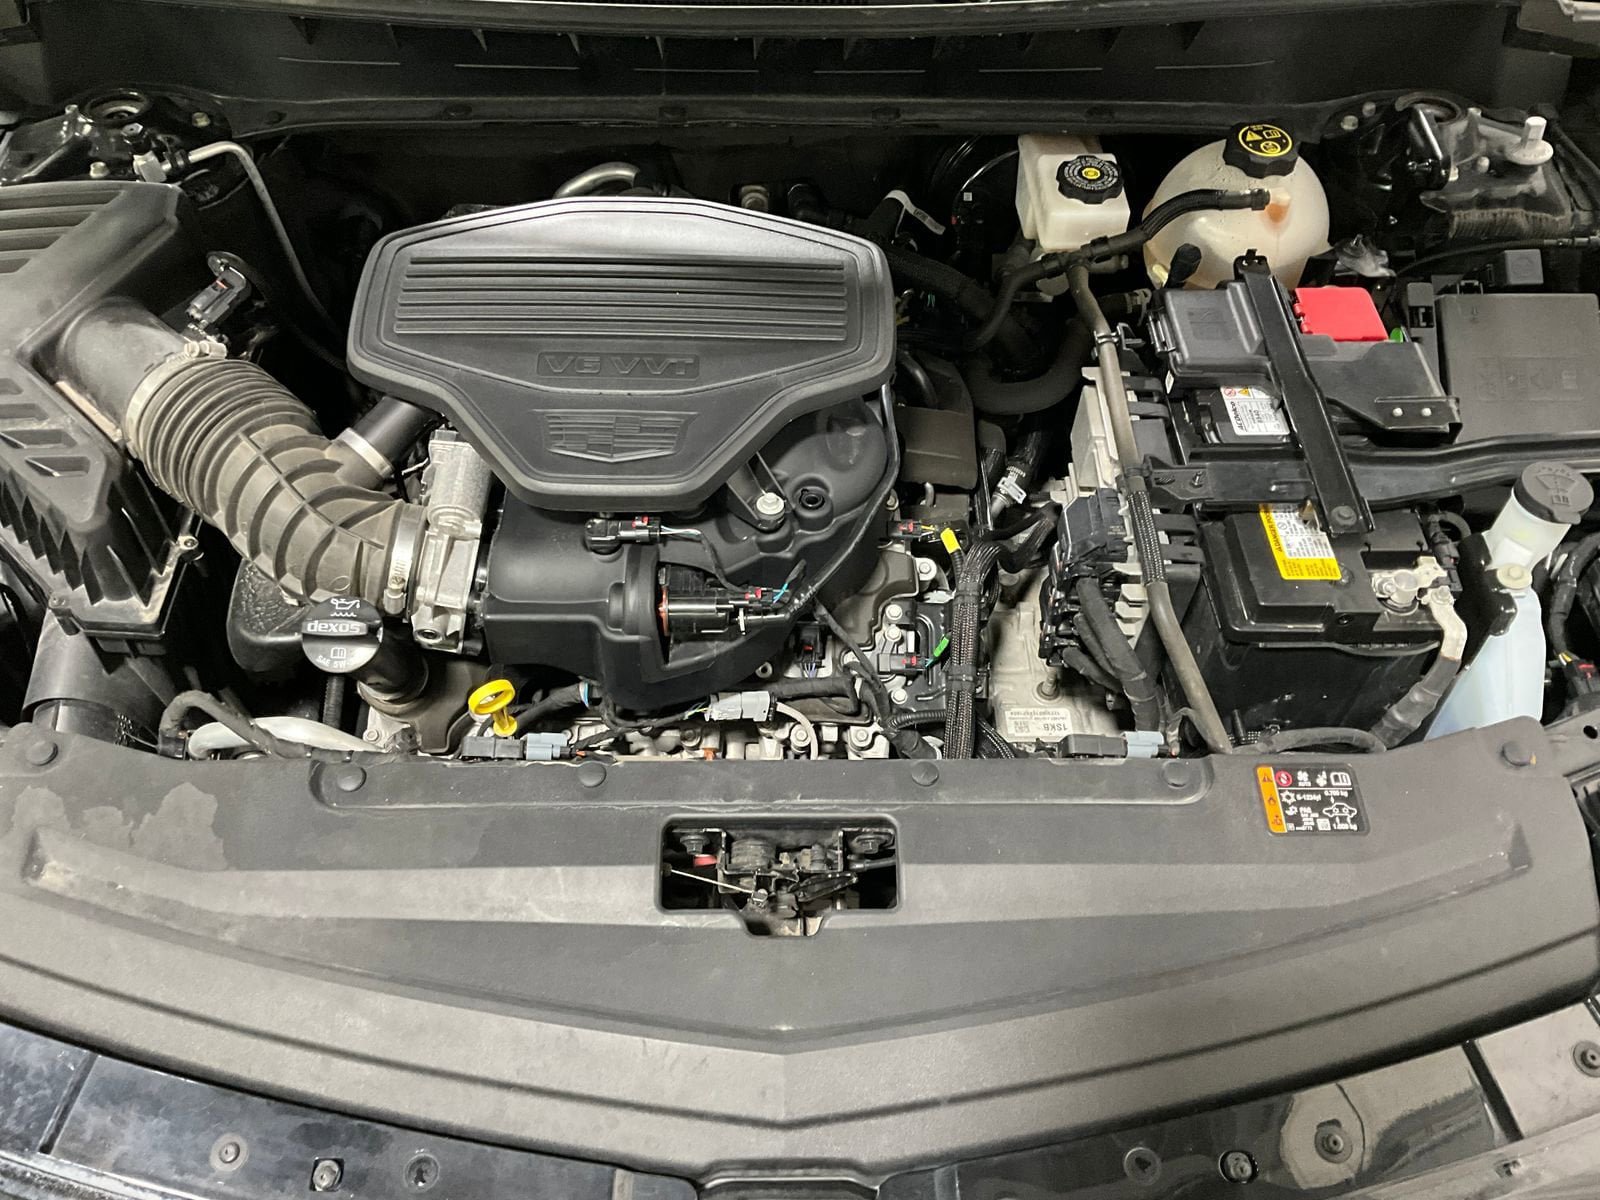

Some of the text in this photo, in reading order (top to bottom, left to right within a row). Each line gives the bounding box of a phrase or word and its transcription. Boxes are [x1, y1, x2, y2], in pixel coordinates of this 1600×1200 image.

[544, 355, 695, 375] V6 VVT
[306, 620, 361, 633] dexos
[315, 655, 331, 667] SAE
